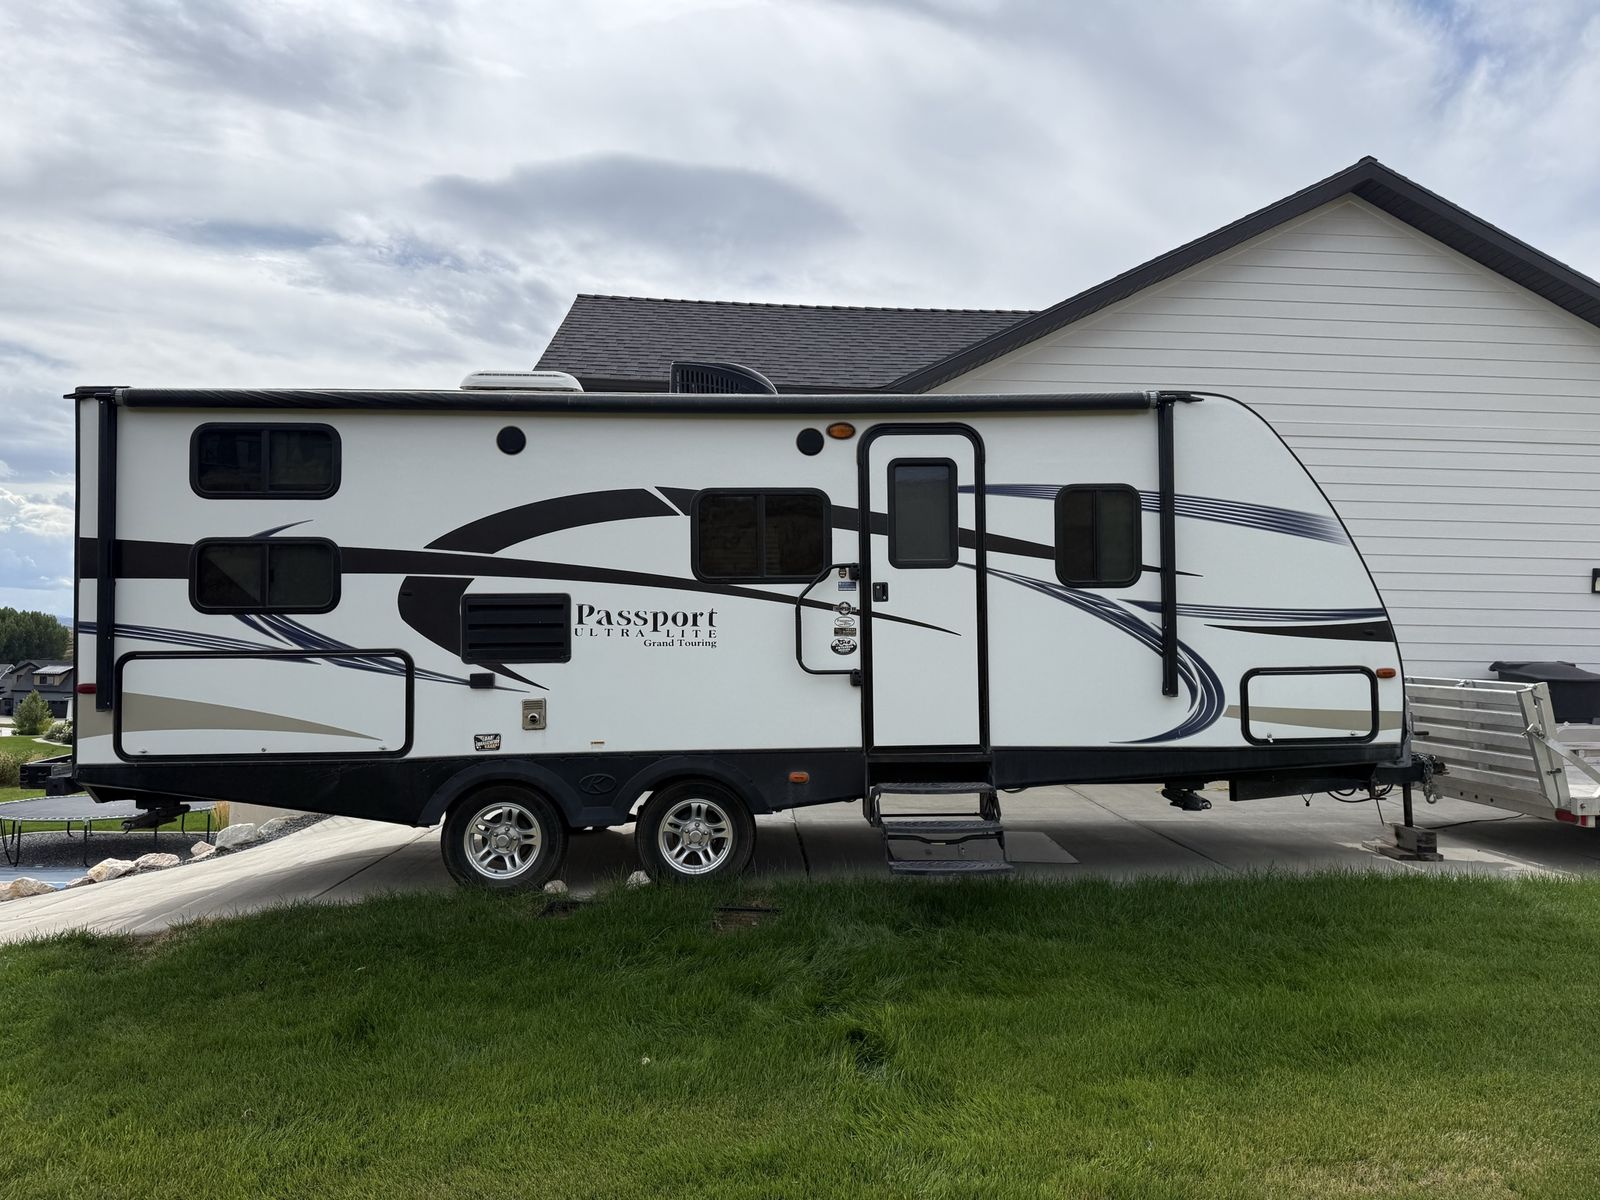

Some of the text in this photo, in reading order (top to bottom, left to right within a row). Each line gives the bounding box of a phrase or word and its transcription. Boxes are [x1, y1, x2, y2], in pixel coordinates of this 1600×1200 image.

[576, 603, 718, 633] Passport
[574, 628, 717, 639] ULTRA LITE
[643, 639, 717, 649] Grand Touring
